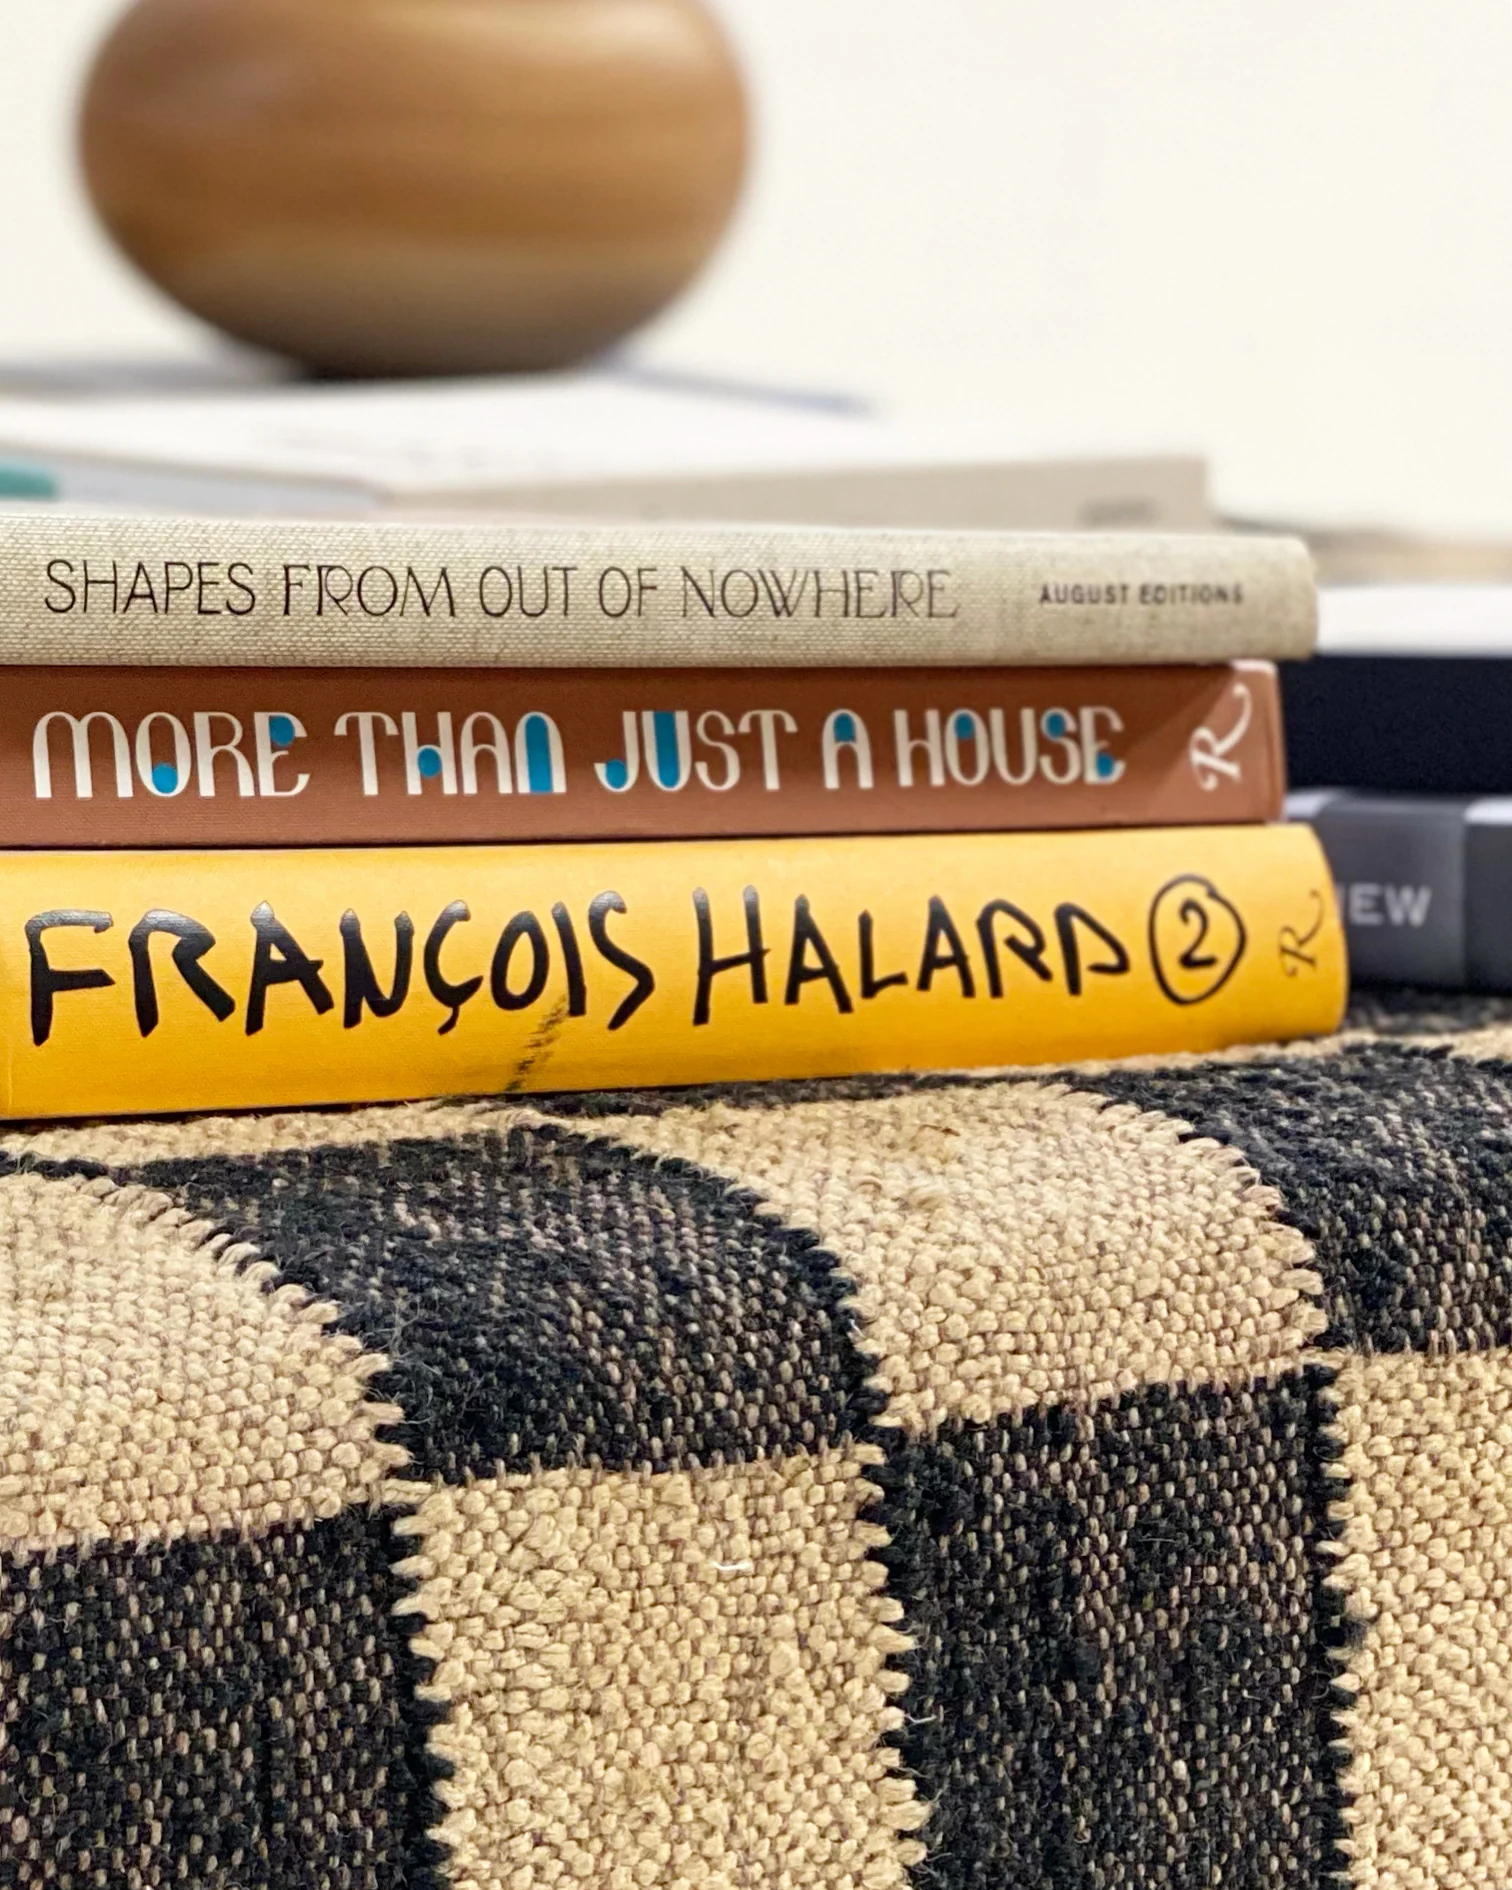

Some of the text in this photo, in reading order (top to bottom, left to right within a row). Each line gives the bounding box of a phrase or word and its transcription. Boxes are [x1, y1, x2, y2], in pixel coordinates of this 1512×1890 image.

[42, 559, 960, 620] SHAPES FROM OUT OF NOWHERE
[1039, 583, 1244, 604] AUGUST EDITIONS
[33, 706, 1126, 798] MORE THAN JUST A HOUSE
[24, 890, 656, 1047] FRANÇOIS
[691, 884, 1130, 1026] HALARD
